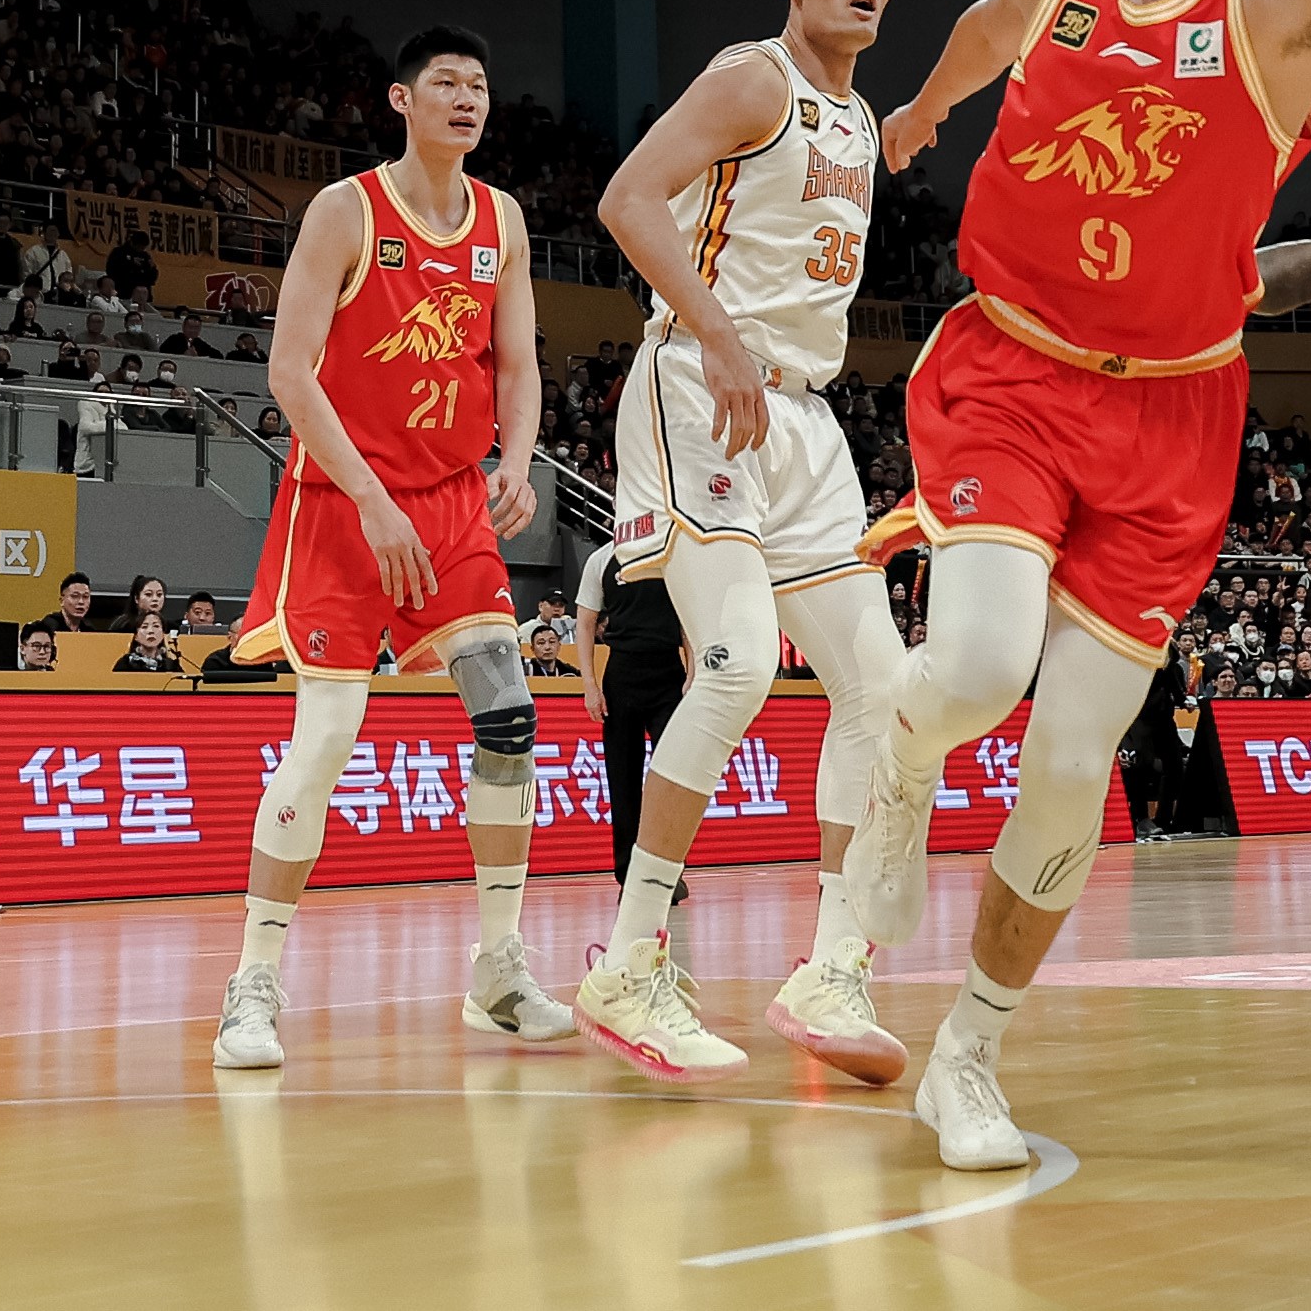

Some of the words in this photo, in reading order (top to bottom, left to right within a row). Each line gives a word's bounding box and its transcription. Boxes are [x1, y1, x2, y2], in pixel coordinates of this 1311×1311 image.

[804, 225, 862, 287] 35
[1078, 216, 1133, 282] 9
[405, 378, 459, 429] 21
[18, 745, 202, 848] 华星
